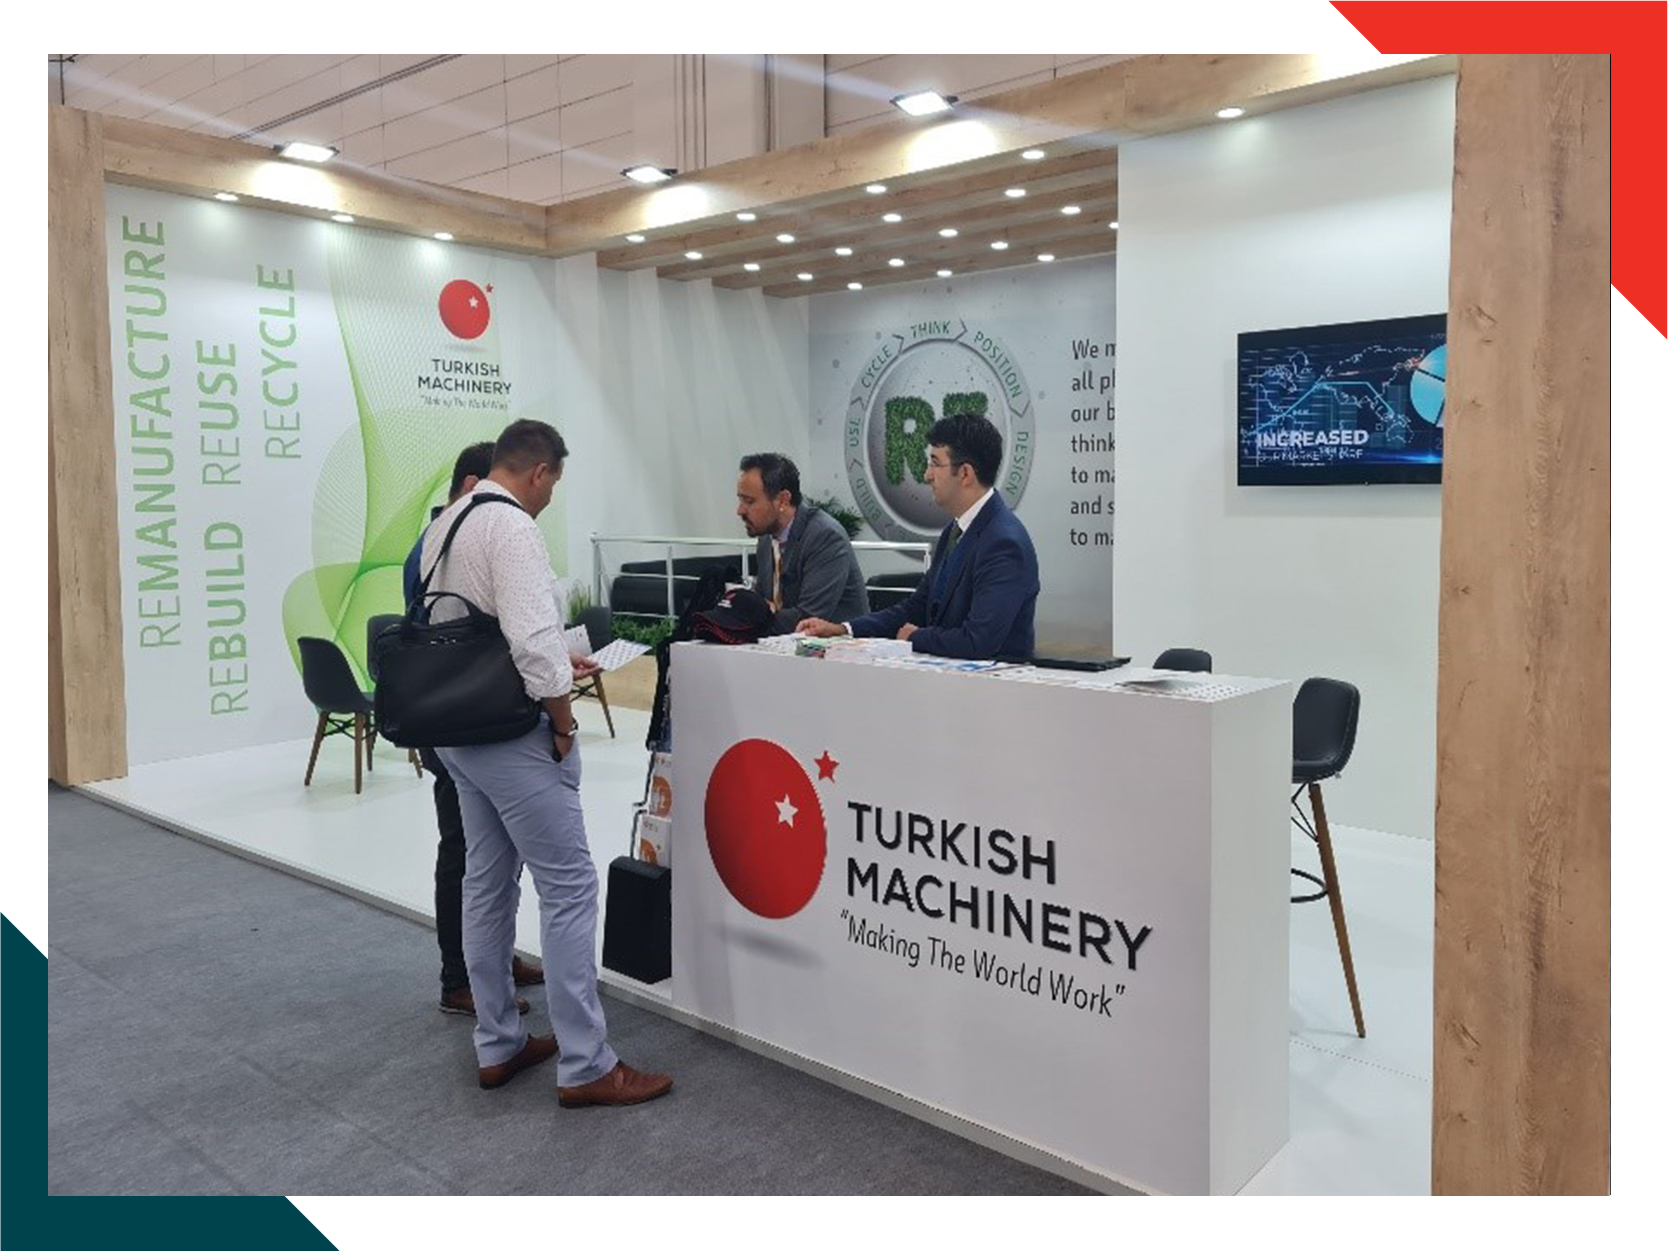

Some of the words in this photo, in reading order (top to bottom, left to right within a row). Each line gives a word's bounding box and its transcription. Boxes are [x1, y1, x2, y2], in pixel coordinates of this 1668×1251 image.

[911, 320, 951, 338] THINK
[1072, 339, 1099, 360] We
[256, 263, 302, 460] RECYCLE
[431, 358, 500, 377] TURKISH
[861, 345, 892, 388] CYCLE
[974, 331, 1023, 398] POSITION
[418, 376, 512, 395] MACHINERY
[1072, 370, 1095, 391] all
[196, 340, 242, 486] REUSE
[1071, 407, 1100, 422] our
[122, 215, 181, 649] REMANUFACTURE
[1071, 432, 1115, 453] think
[1256, 430, 1370, 447] INCREASED
[1006, 431, 1029, 495] DESIGN
[1071, 466, 1088, 483] to
[1071, 495, 1101, 514] and
[1070, 529, 1088, 545] to
[204, 520, 248, 715] REBUILD
[847, 801, 1057, 885] TURKISH
[847, 857, 1153, 970] MACHINERY
[928, 936, 965, 974] The
[973, 949, 1041, 996] World
